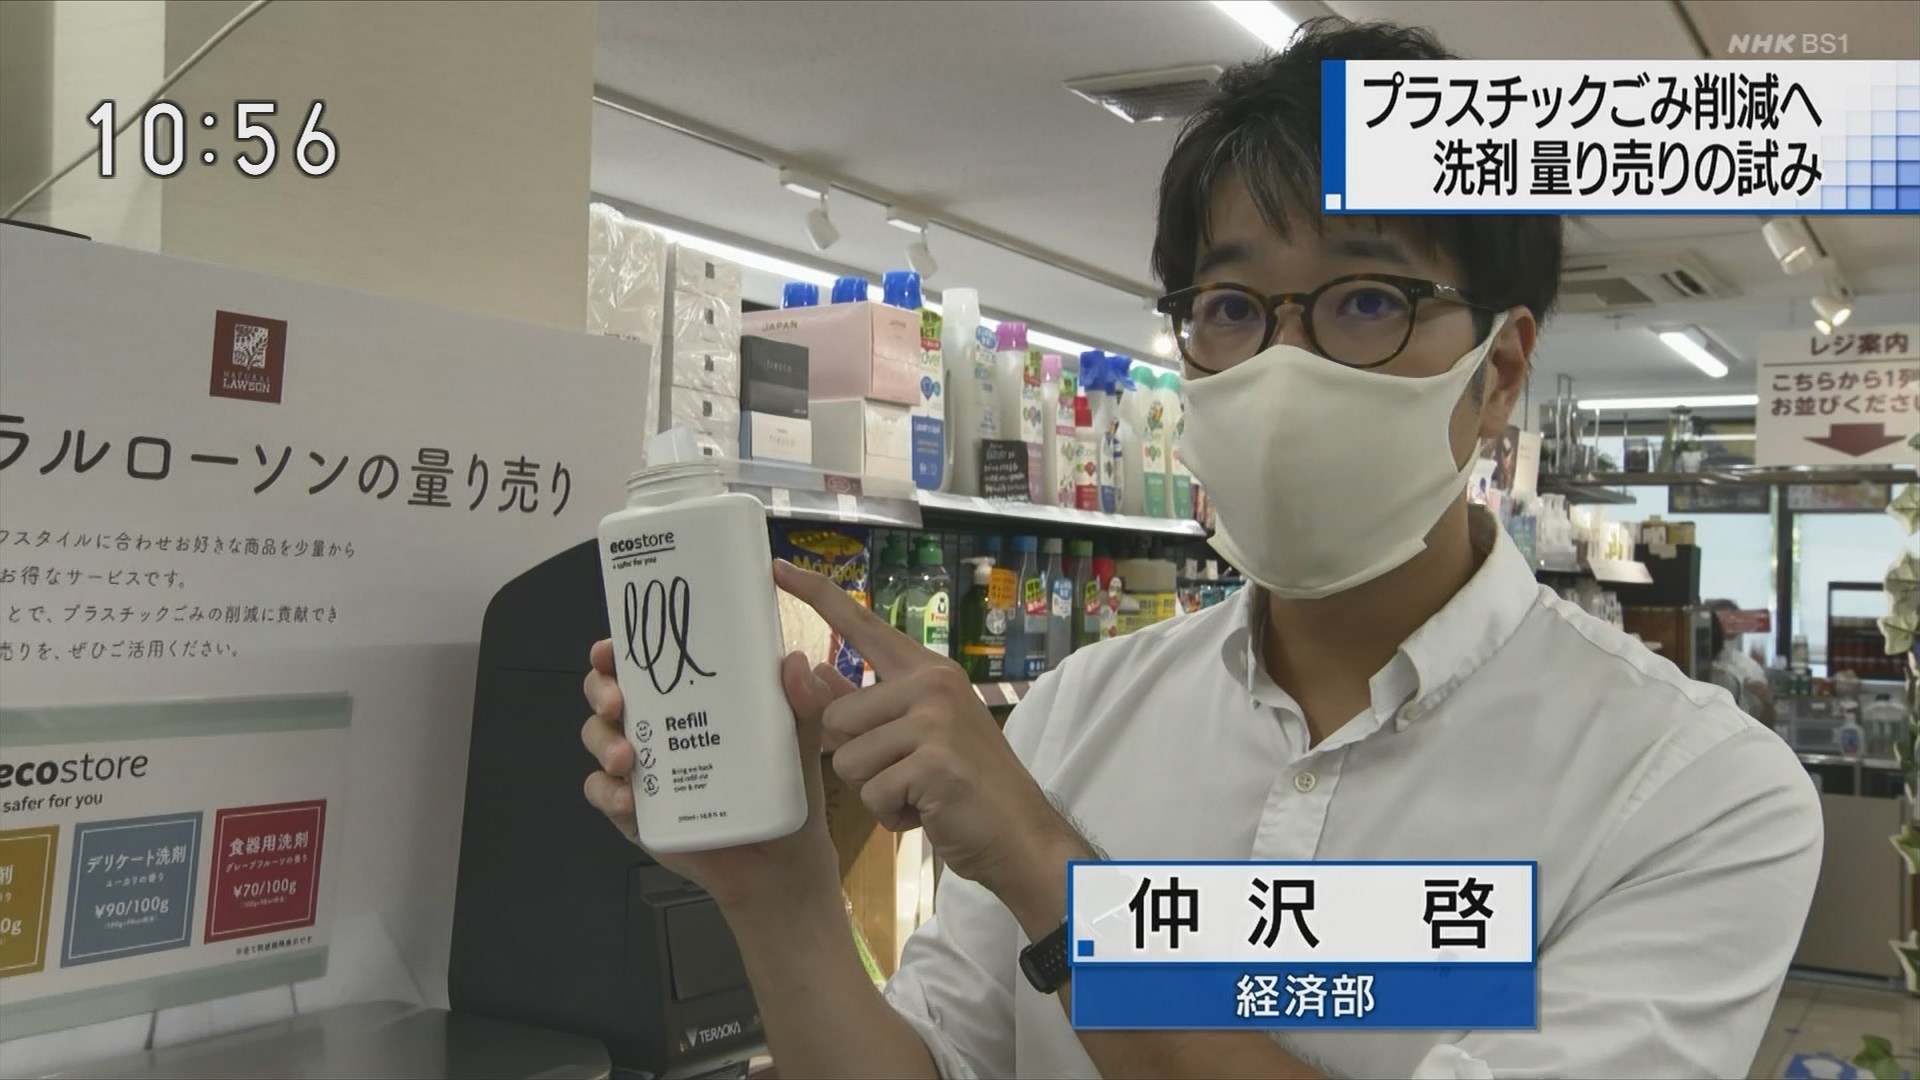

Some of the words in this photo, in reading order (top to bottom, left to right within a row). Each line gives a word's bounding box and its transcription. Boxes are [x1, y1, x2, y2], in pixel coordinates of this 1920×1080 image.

[1810, 332, 1909, 357] レジ案内
[223, 378, 271, 393] LAWSON
[610, 531, 675, 554] ecostore
[0, 565, 187, 589] お得なサービスです。
[665, 710, 708, 731] Refill
[668, 731, 721, 751] Bottle
[0, 753, 149, 789] ecostore
[3, 796, 45, 813] safer
[49, 793, 73, 809] for
[75, 792, 103, 809] you
[228, 830, 309, 857] 食器用洗剤
[87, 844, 187, 873] デリケート洗剤
[233, 878, 297, 899] ¥70/100g
[95, 896, 169, 919] ¥90/100g
[699, 1021, 741, 1043] TERAOKA
